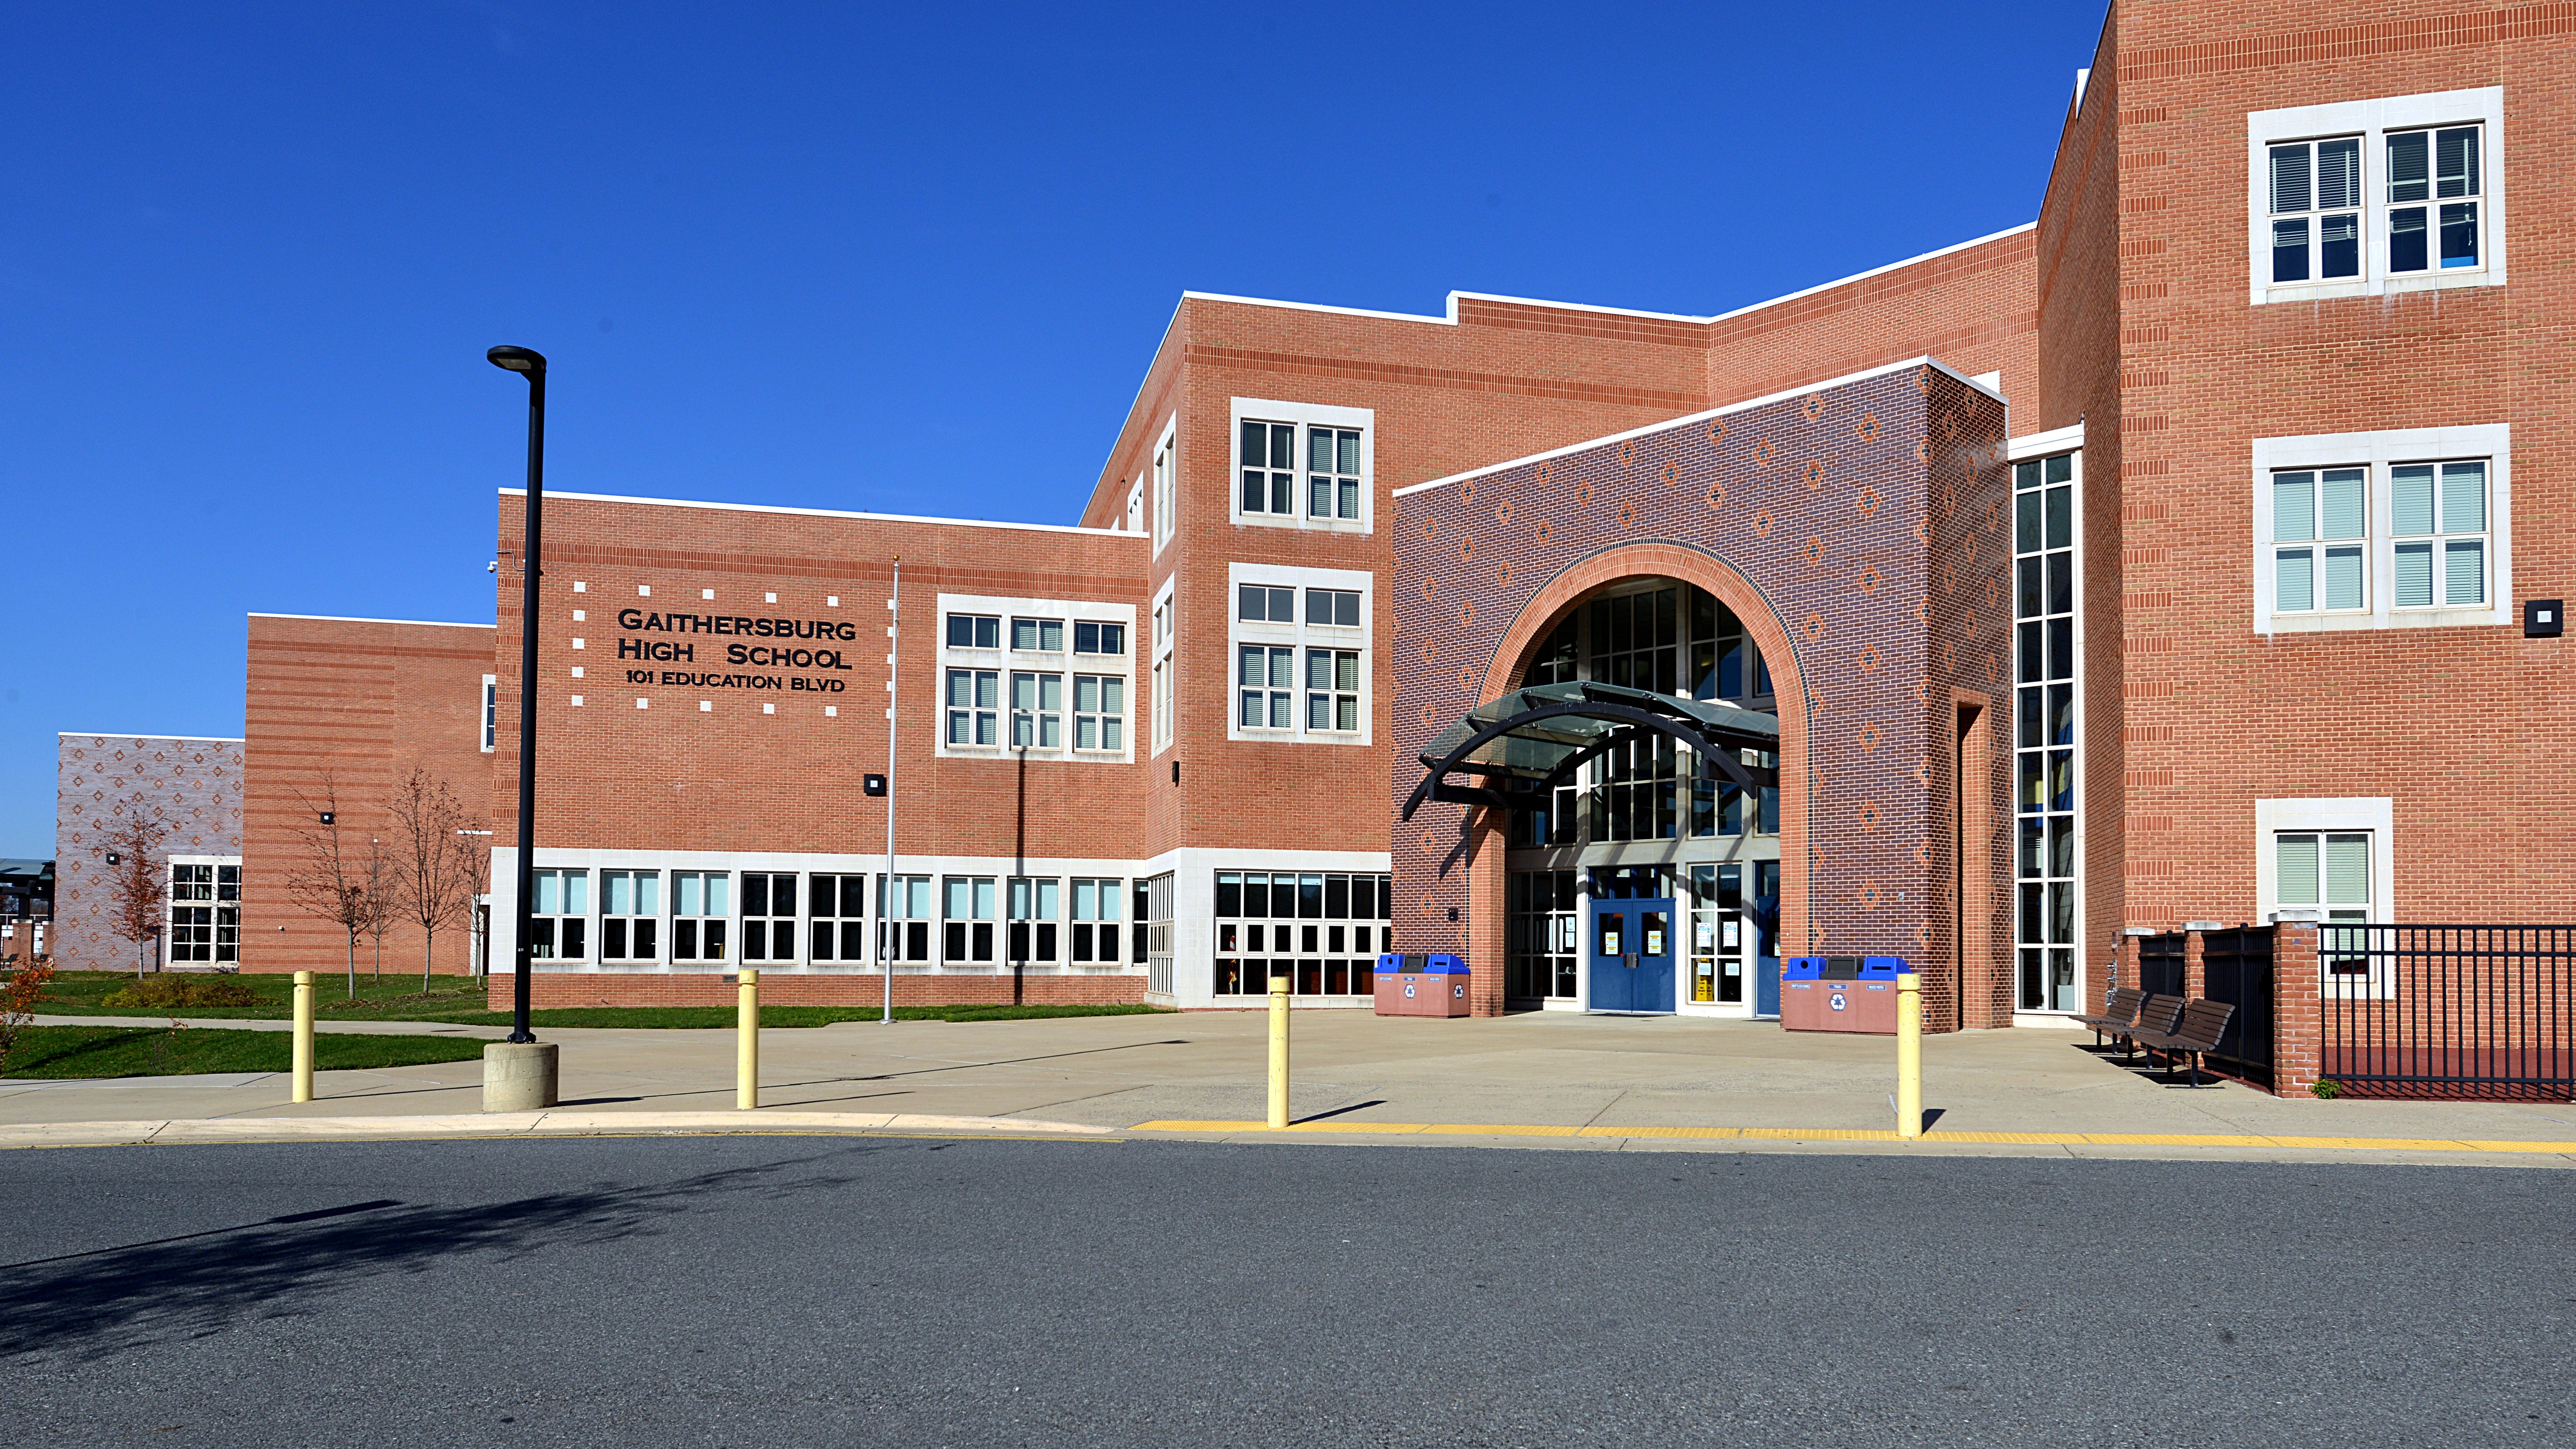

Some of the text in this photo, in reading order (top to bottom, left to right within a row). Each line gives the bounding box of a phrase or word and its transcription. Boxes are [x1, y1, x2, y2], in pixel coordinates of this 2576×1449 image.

[618, 608, 856, 641] GAITHERSBURG
[618, 638, 852, 670] HIGH SCHOOL
[626, 670, 845, 692] 101 EDUCATION BLVD
